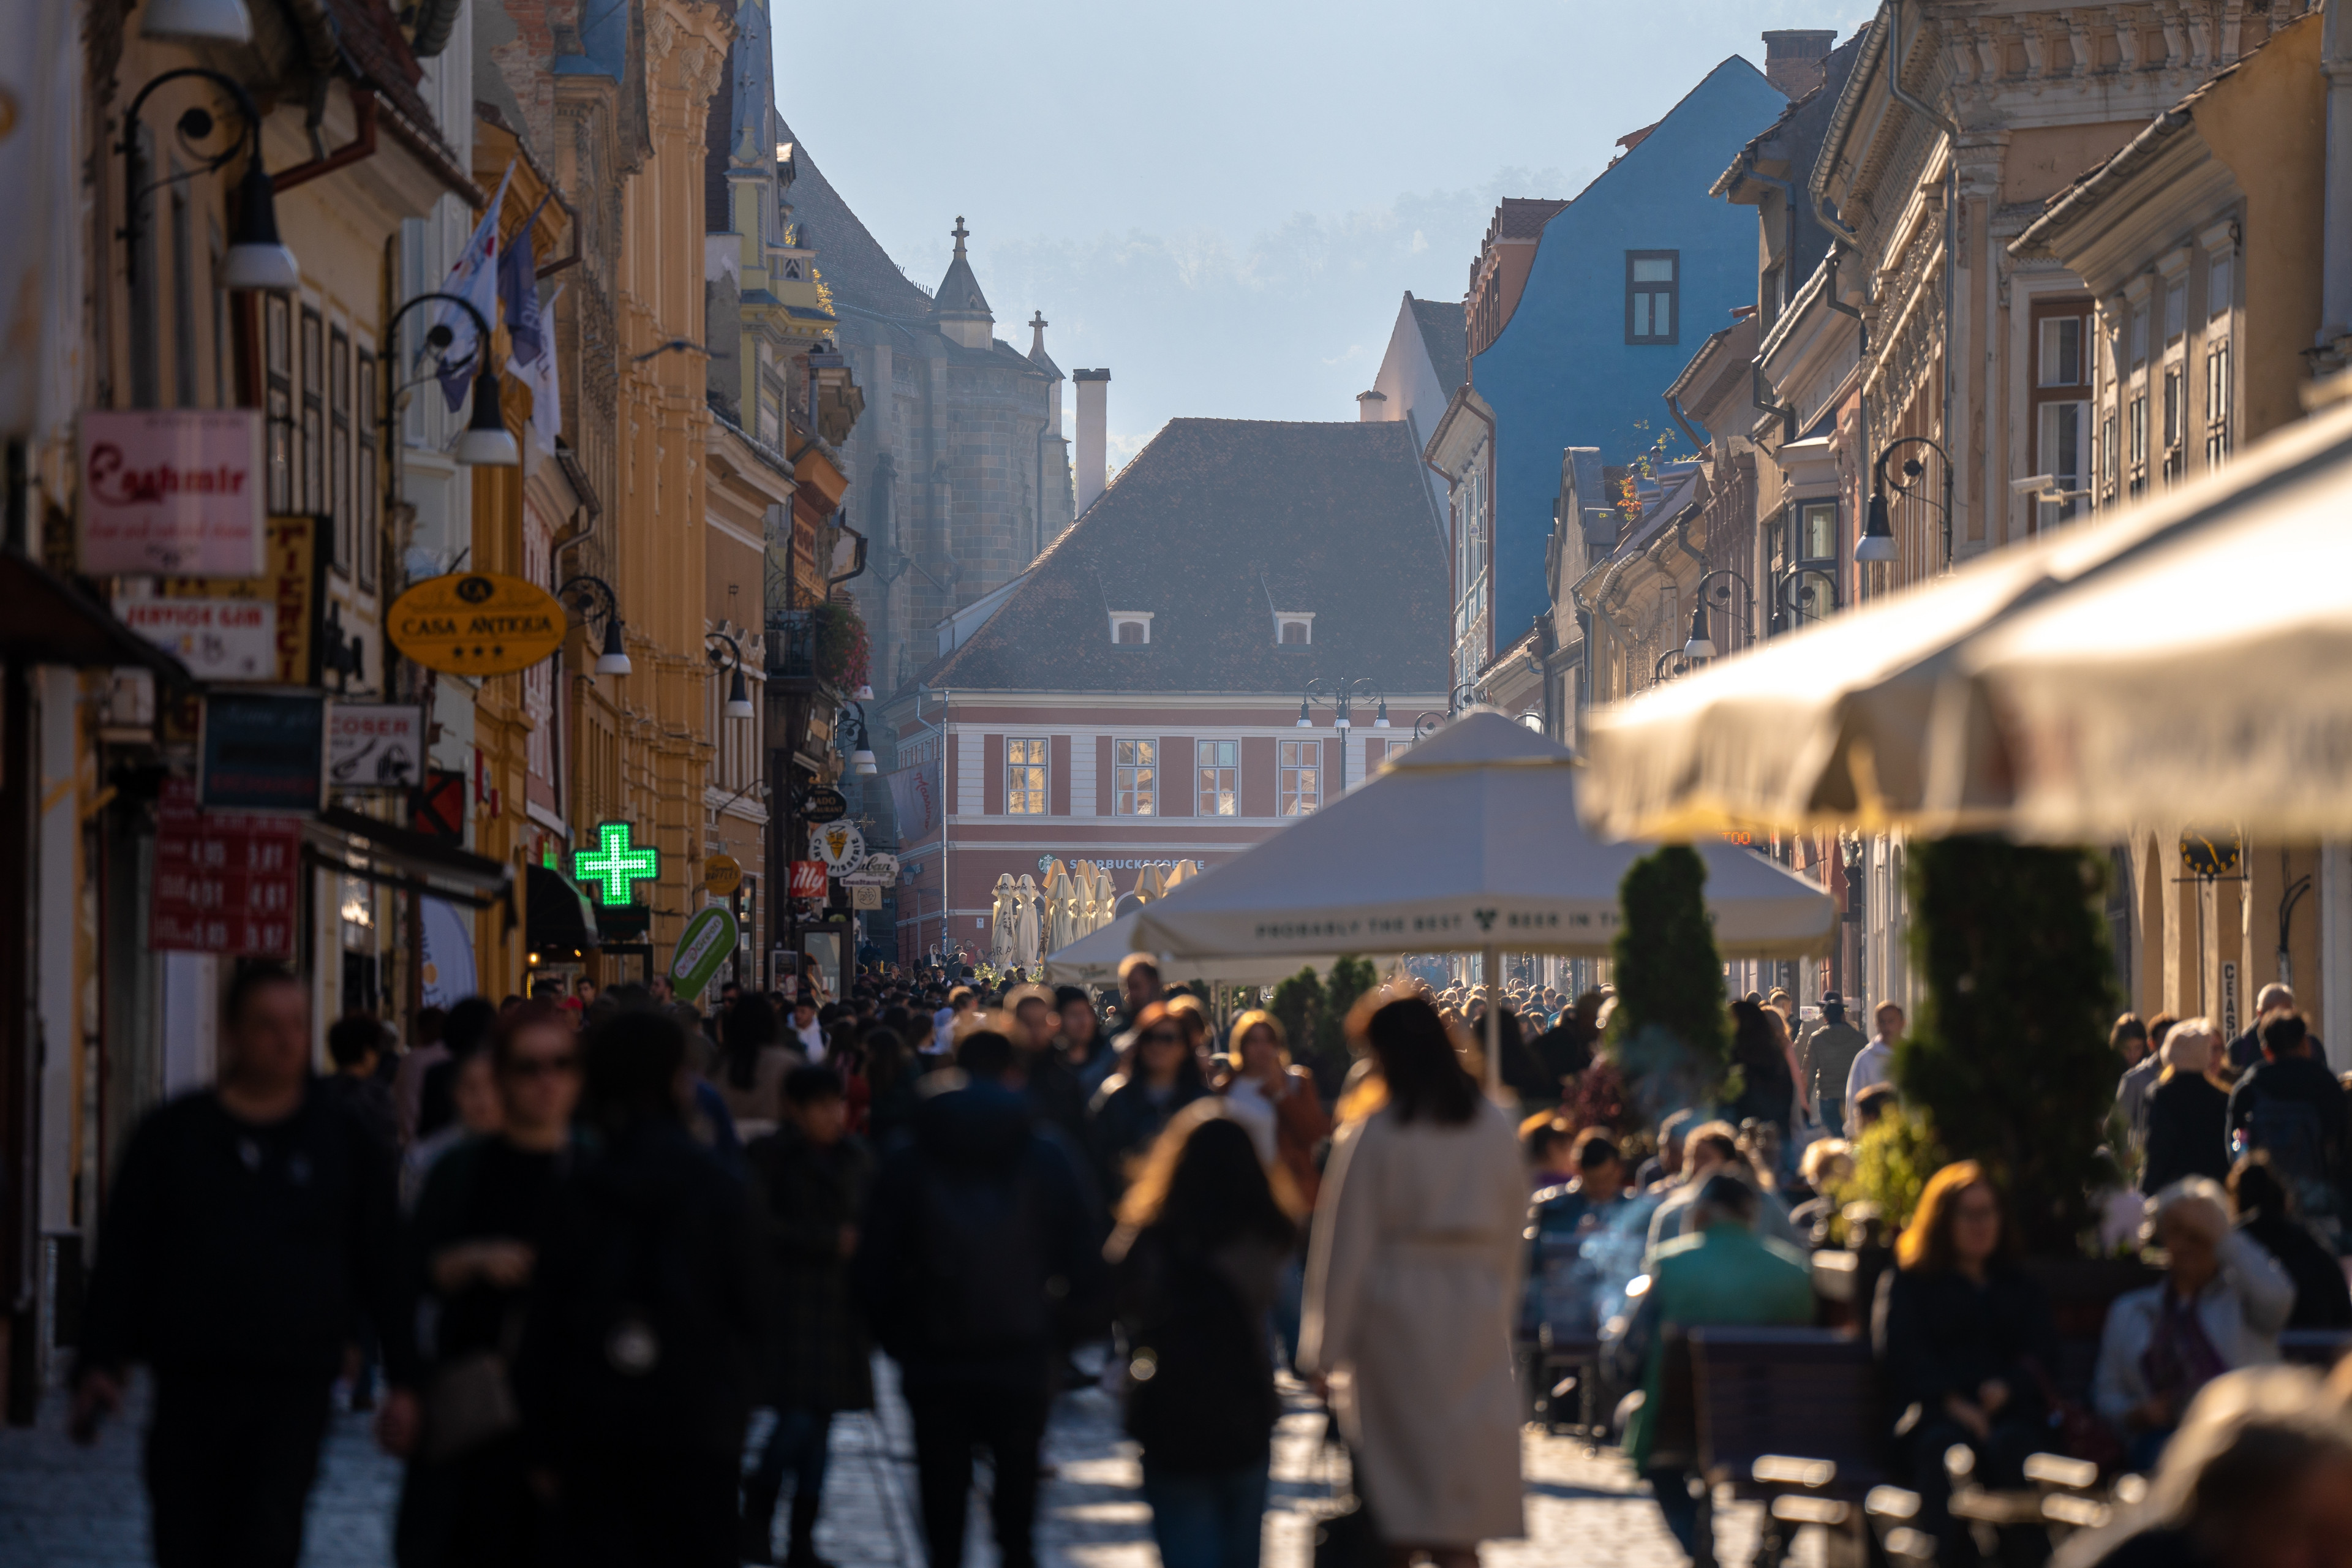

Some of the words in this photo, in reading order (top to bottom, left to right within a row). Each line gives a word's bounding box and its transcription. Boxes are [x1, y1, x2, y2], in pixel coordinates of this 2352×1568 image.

[402, 617, 457, 635] CASA
[813, 837, 861, 872] CARFISSERIE
[1069, 859, 1152, 869] SRBUCKS
[1153, 860, 1205, 870] COFE
[793, 867, 825, 895] illy
[1256, 919, 1359, 938] PROBABLY
[1370, 916, 1404, 934] THE
[1414, 914, 1461, 932] BEST
[1509, 912, 1558, 928] BEER
[1569, 913, 1589, 927] IN
[1600, 912, 1622, 927] TH
